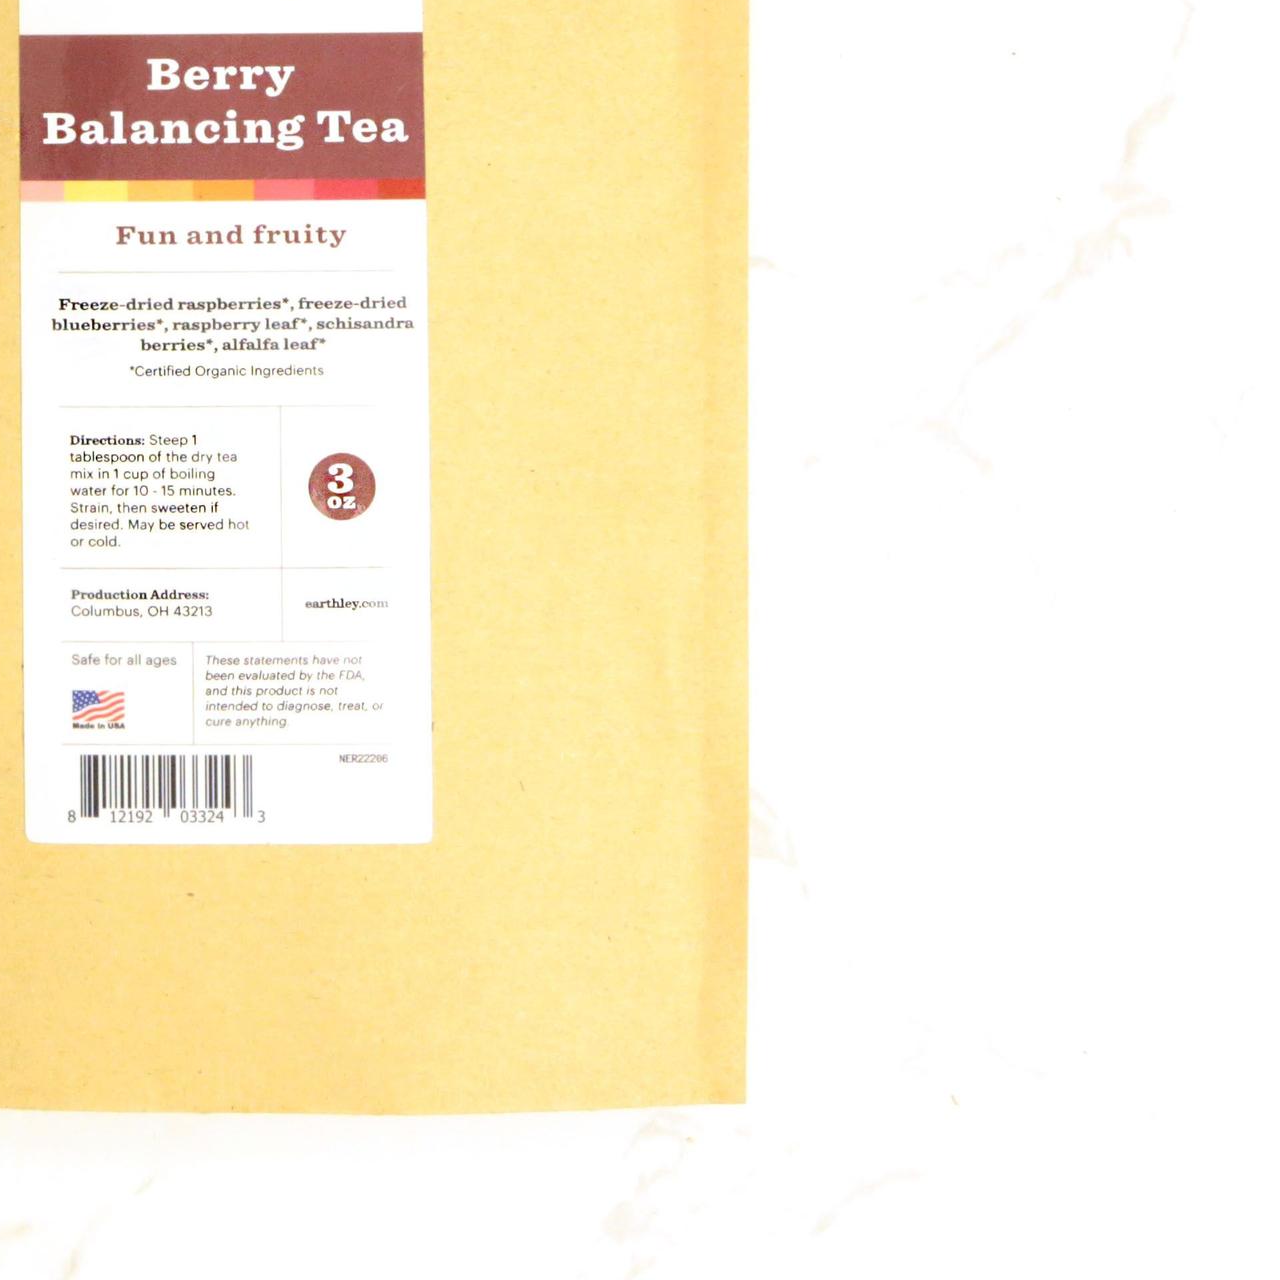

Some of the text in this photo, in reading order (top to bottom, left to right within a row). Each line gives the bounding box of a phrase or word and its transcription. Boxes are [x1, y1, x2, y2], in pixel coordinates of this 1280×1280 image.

[146, 58, 295, 97] Berry
[42, 110, 409, 151] Balancing Tea
[116, 224, 347, 248] Fun and fruity
[58, 298, 174, 311] Freeze-dried
[298, 296, 407, 309] freeze-dried
[172, 318, 260, 333] raspberry
[316, 317, 414, 330] schisandra
[222, 338, 279, 351] alfalfa
[195, 365, 246, 379] Organic
[251, 365, 324, 378] Ingredients
[70, 435, 197, 447] Directions: Steep 1
[70, 452, 237, 464] tablespoon of the dry tea
[70, 468, 215, 481] mix in 1 cup of boiling
[327, 463, 354, 494] 3
[70, 486, 106, 496] water
[112, 486, 129, 496] for
[134, 486, 148, 496] 10
[162, 485, 174, 496] 15
[179, 486, 236, 496] minutes.
[70, 502, 219, 515] Strain, then sweeten if
[70, 519, 249, 532] desired. May be served hot
[70, 536, 120, 548] or cold.
[71, 589, 209, 600] Production Address:
[305, 598, 389, 610] earthley.com
[71, 605, 213, 618] Columbus, OH 43213
[72, 654, 177, 667] Safe for all ages
[206, 654, 362, 666] These statements have not
[205, 670, 365, 682] been evaluated by the FDA,
[205, 686, 338, 697] and this product is not
[205, 701, 384, 713] intended to diagnose, treat, or
[205, 718, 232, 726] cure
[68, 810, 265, 823] 8 12192 03324 3
